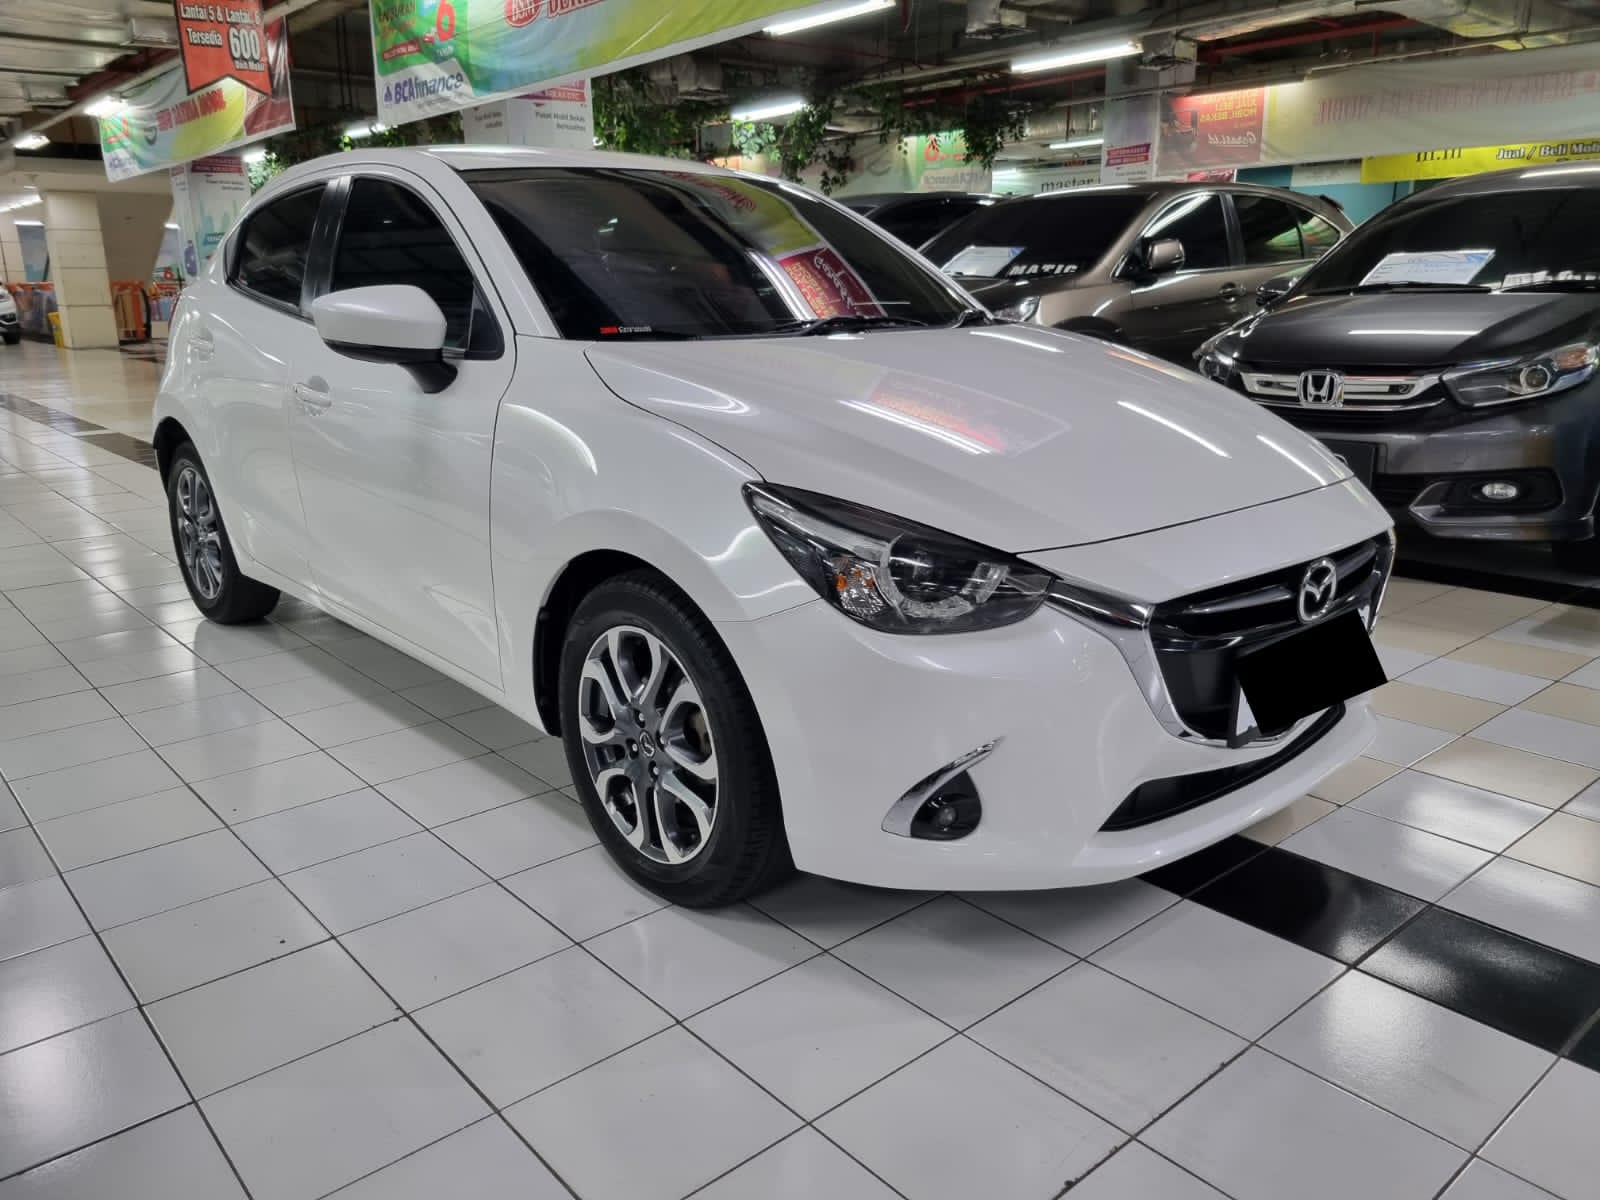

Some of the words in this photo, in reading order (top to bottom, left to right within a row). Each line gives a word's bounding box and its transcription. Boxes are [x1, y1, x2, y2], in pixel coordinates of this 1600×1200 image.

[181, 3, 207, 20] Lantai
[208, 6, 215, 21] 5
[229, 27, 261, 61] 600
[1496, 147, 1525, 160] Jual
